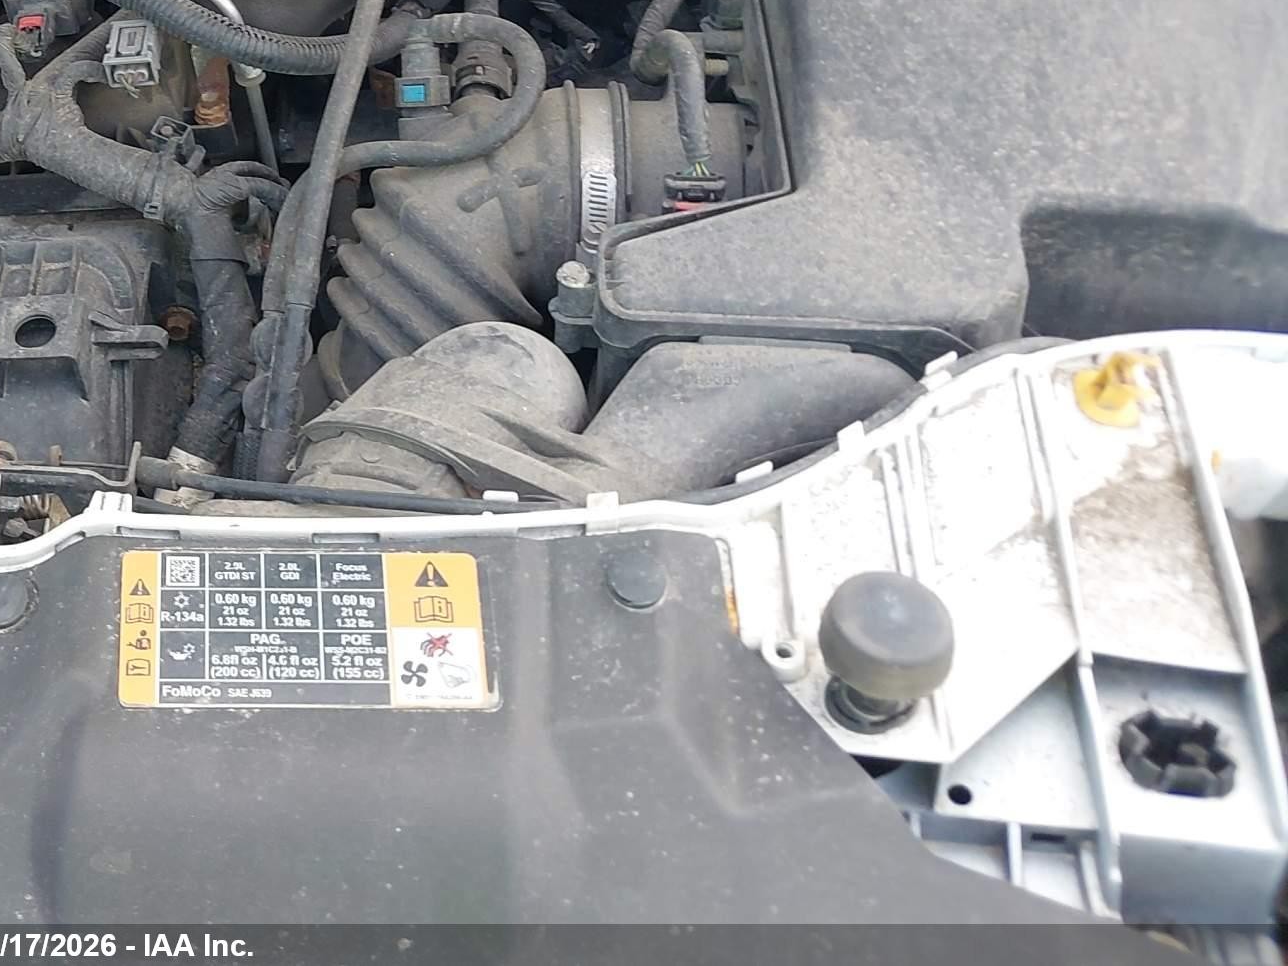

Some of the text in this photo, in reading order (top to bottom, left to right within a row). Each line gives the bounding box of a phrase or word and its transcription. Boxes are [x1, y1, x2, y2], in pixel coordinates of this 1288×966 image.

[335, 562, 368, 571] Focus
[214, 571, 257, 580] GTDI ST
[279, 571, 300, 580] GDI
[332, 571, 372, 581] Electric
[214, 593, 257, 607] 0.60 kg
[269, 593, 312, 607] 0.60 kg
[332, 594, 375, 608] 0.60 kg
[222, 606, 235, 615] 21
[278, 607, 305, 616] 21 oz
[340, 608, 369, 617] 21 oz
[161, 611, 205, 622] R-134a
[216, 617, 256, 626] 1.32 lbs
[272, 618, 312, 627] 1.32 lbs
[335, 618, 375, 628] 1.32 lbs
[341, 634, 372, 645] POE
[241, 657, 258, 665] oz
[289, 655, 300, 666] fl
[301, 657, 319, 666] oz
[331, 655, 383, 666] 5.2 fl oz
[210, 665, 261, 679] (200 cc)
[268, 666, 320, 679] (120 cc)
[332, 667, 385, 680] (155 cc)
[162, 685, 221, 698] FoMoCo
[227, 688, 248, 698] SAE
